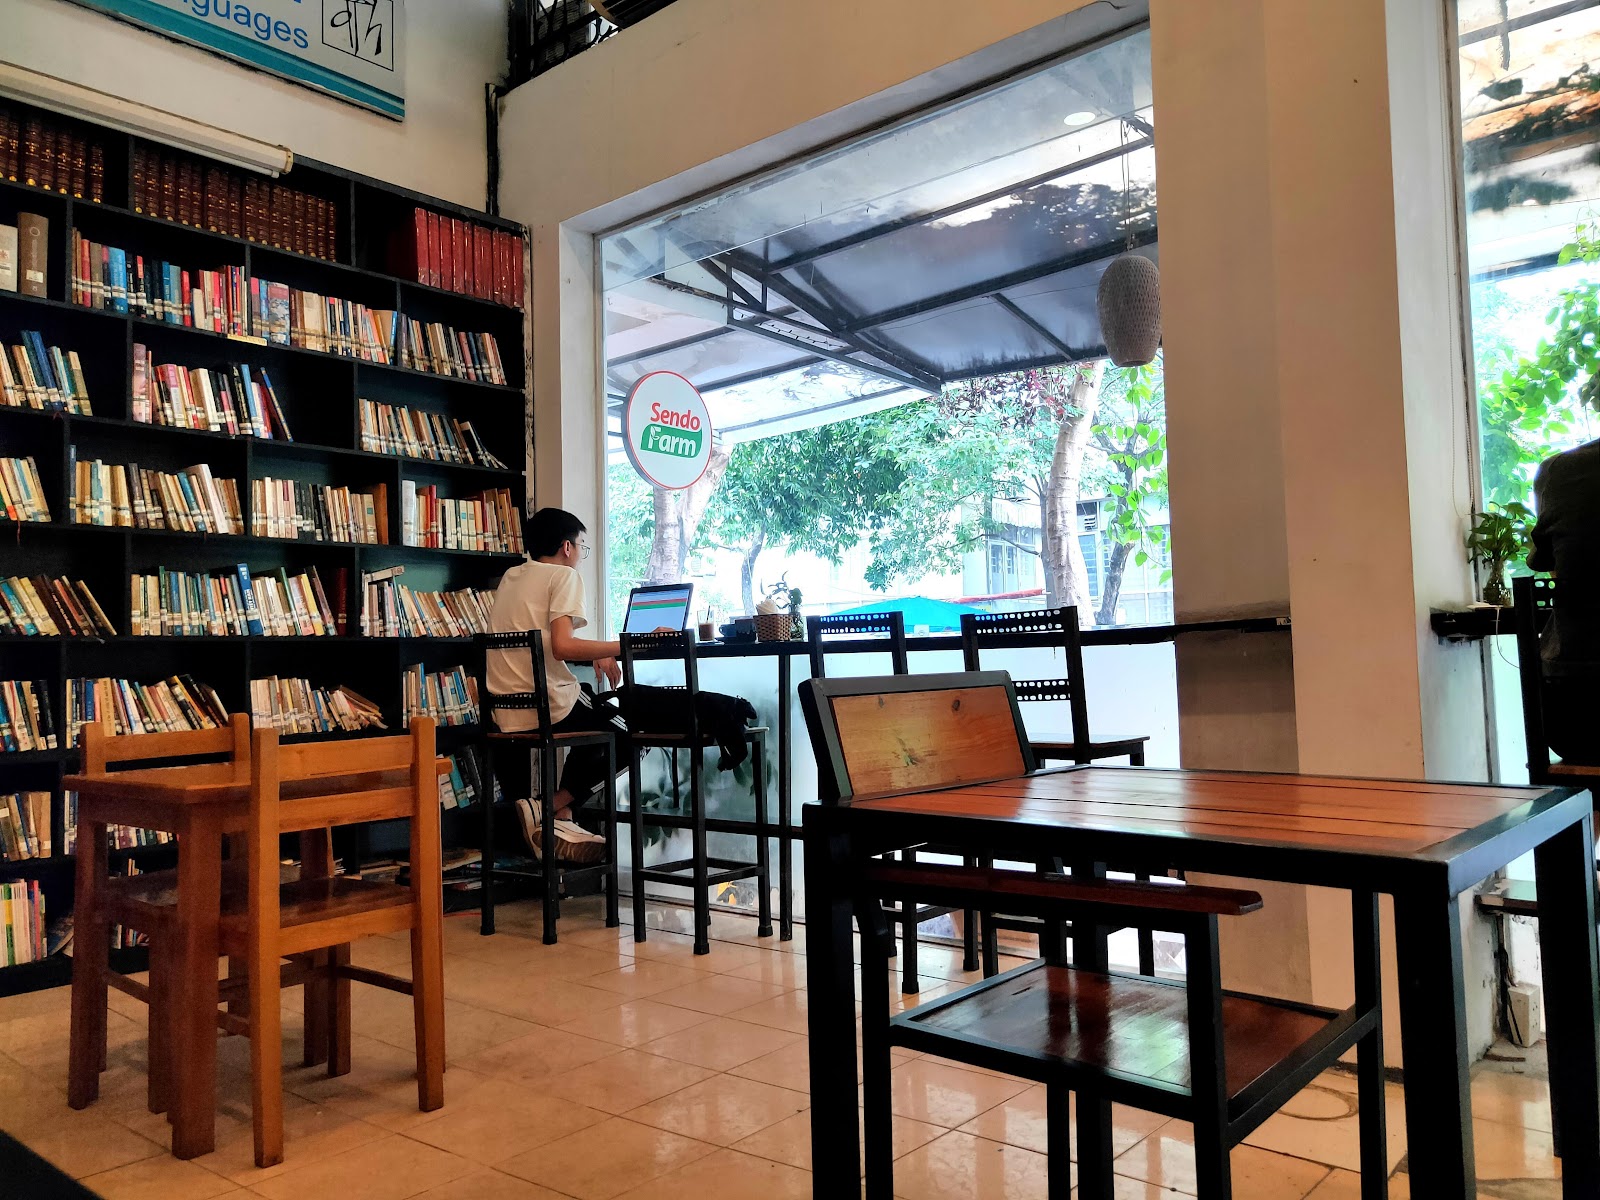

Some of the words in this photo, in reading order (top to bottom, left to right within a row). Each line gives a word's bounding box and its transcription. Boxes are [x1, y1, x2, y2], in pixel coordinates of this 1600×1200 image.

[183, 0, 309, 49] guages
[650, 402, 701, 431] Sendo
[647, 426, 697, 457] Farm
